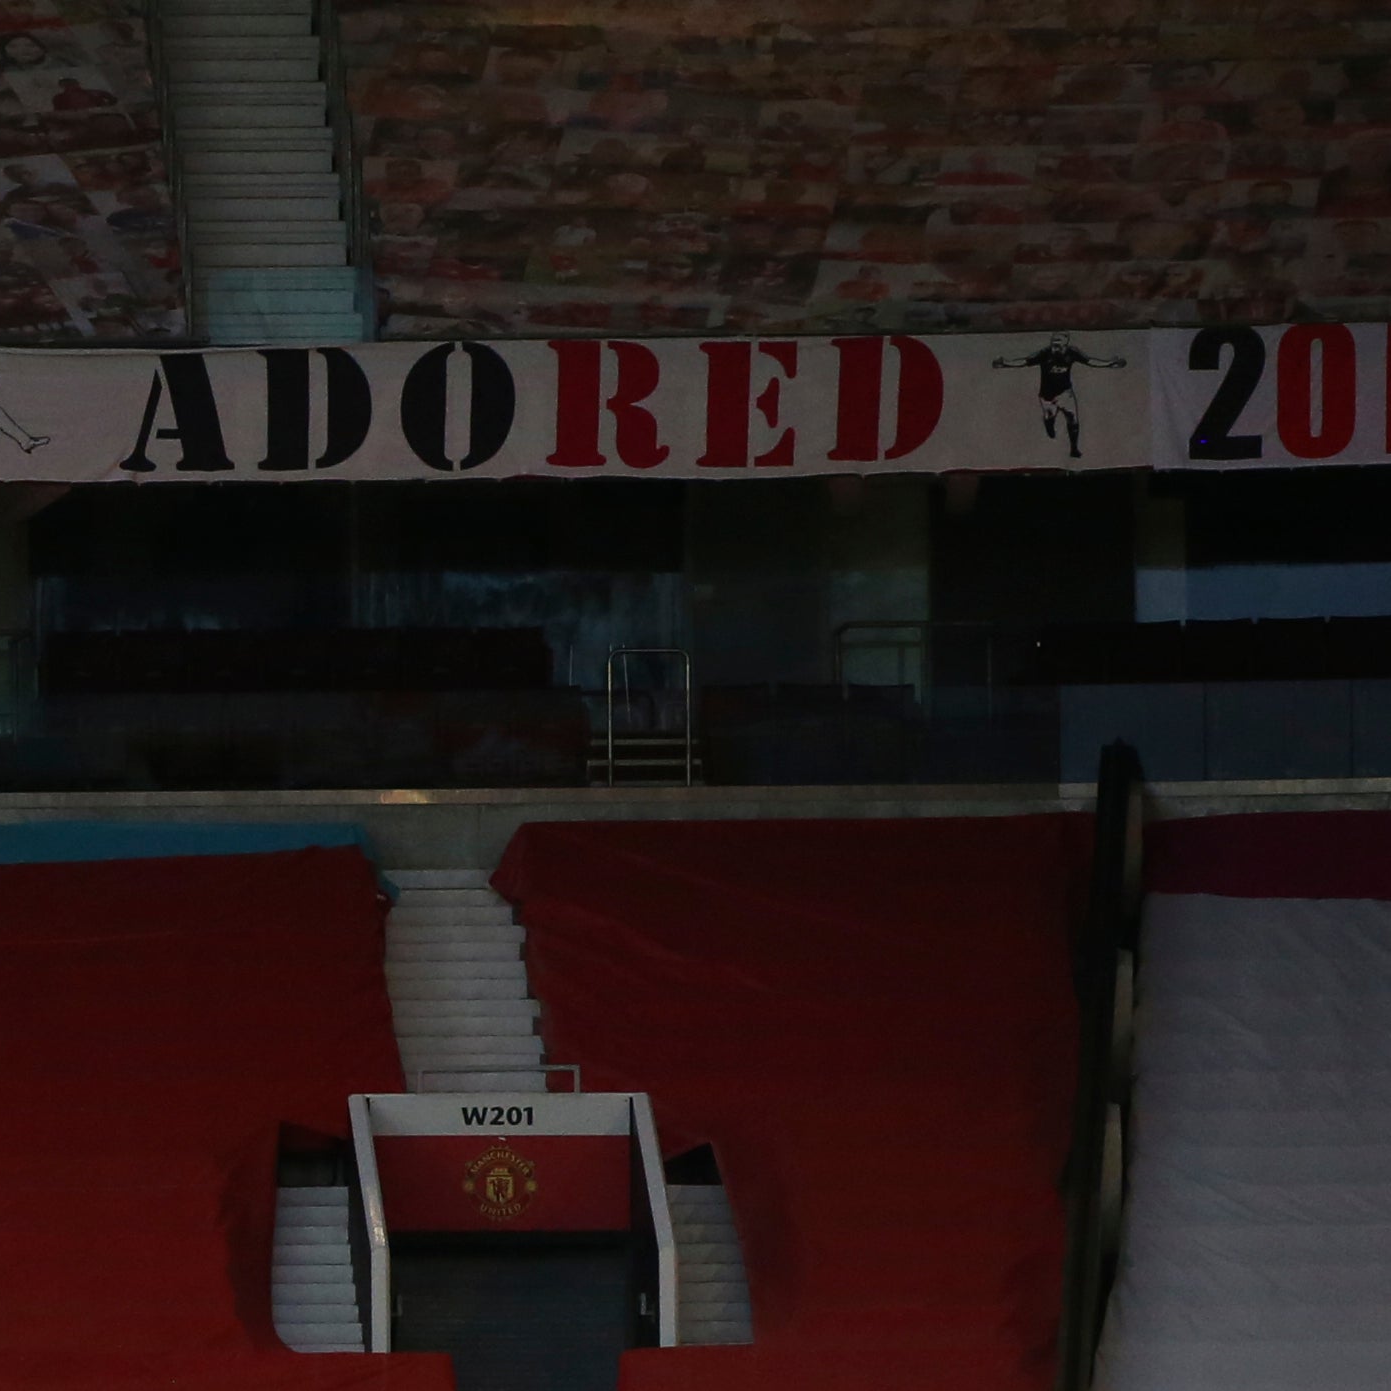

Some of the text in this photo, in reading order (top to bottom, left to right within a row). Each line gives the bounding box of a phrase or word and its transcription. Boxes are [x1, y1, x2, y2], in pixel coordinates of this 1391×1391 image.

[119, 338, 944, 472] ADORED
[1188, 321, 1391, 460] 20
[461, 1106, 534, 1126] W201
